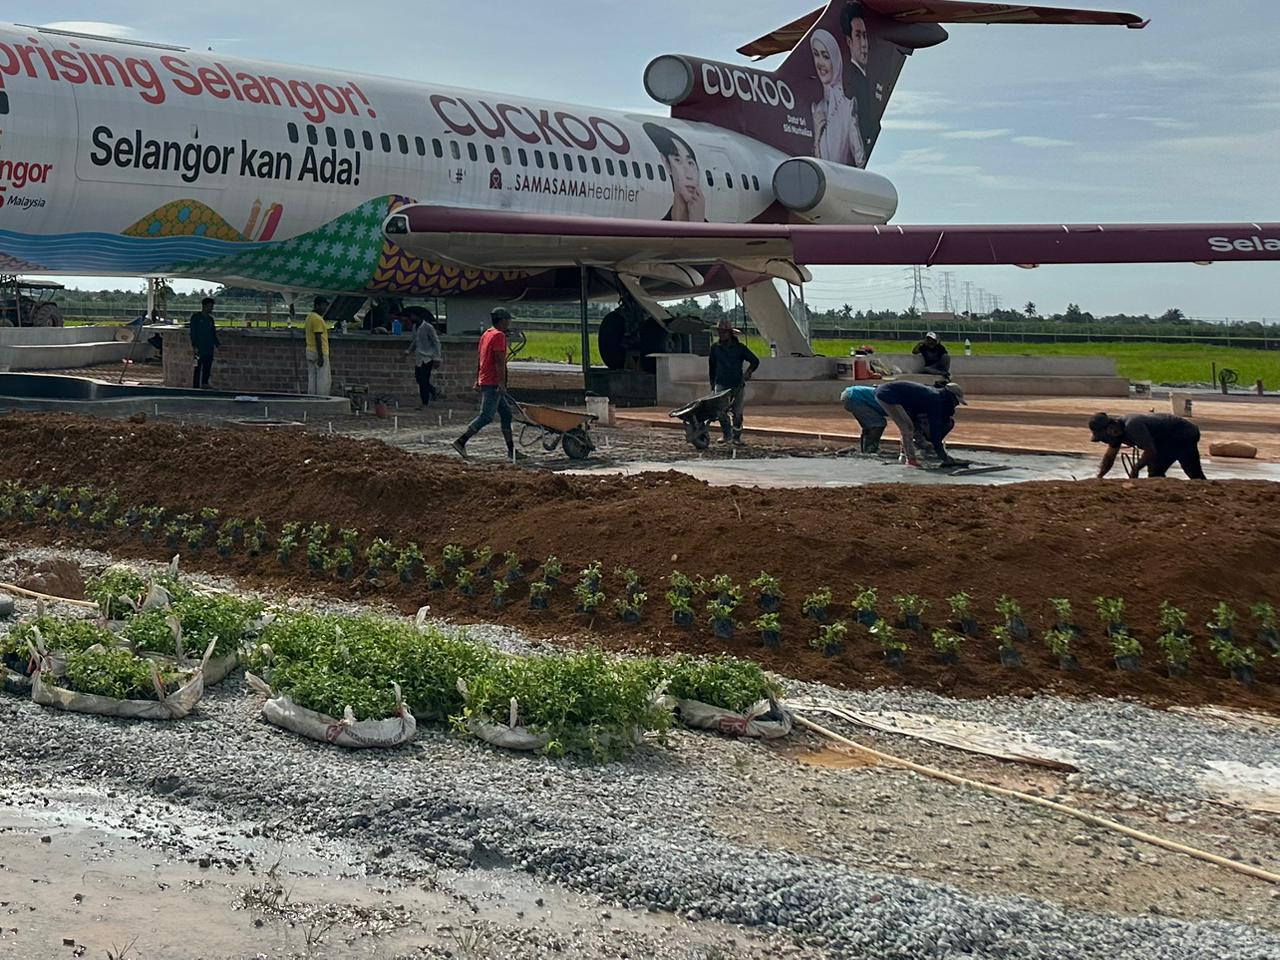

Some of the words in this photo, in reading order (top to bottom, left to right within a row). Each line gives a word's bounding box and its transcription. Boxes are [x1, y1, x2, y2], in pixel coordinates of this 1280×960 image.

[160, 55, 377, 123] Selangor!
[701, 63, 795, 110] CUCKOO
[429, 94, 631, 155] CUCKOO
[90, 125, 234, 183] Selangor
[240, 139, 292, 180] kan
[297, 146, 361, 186] Ada!
[7, 195, 46, 210] Malaysia
